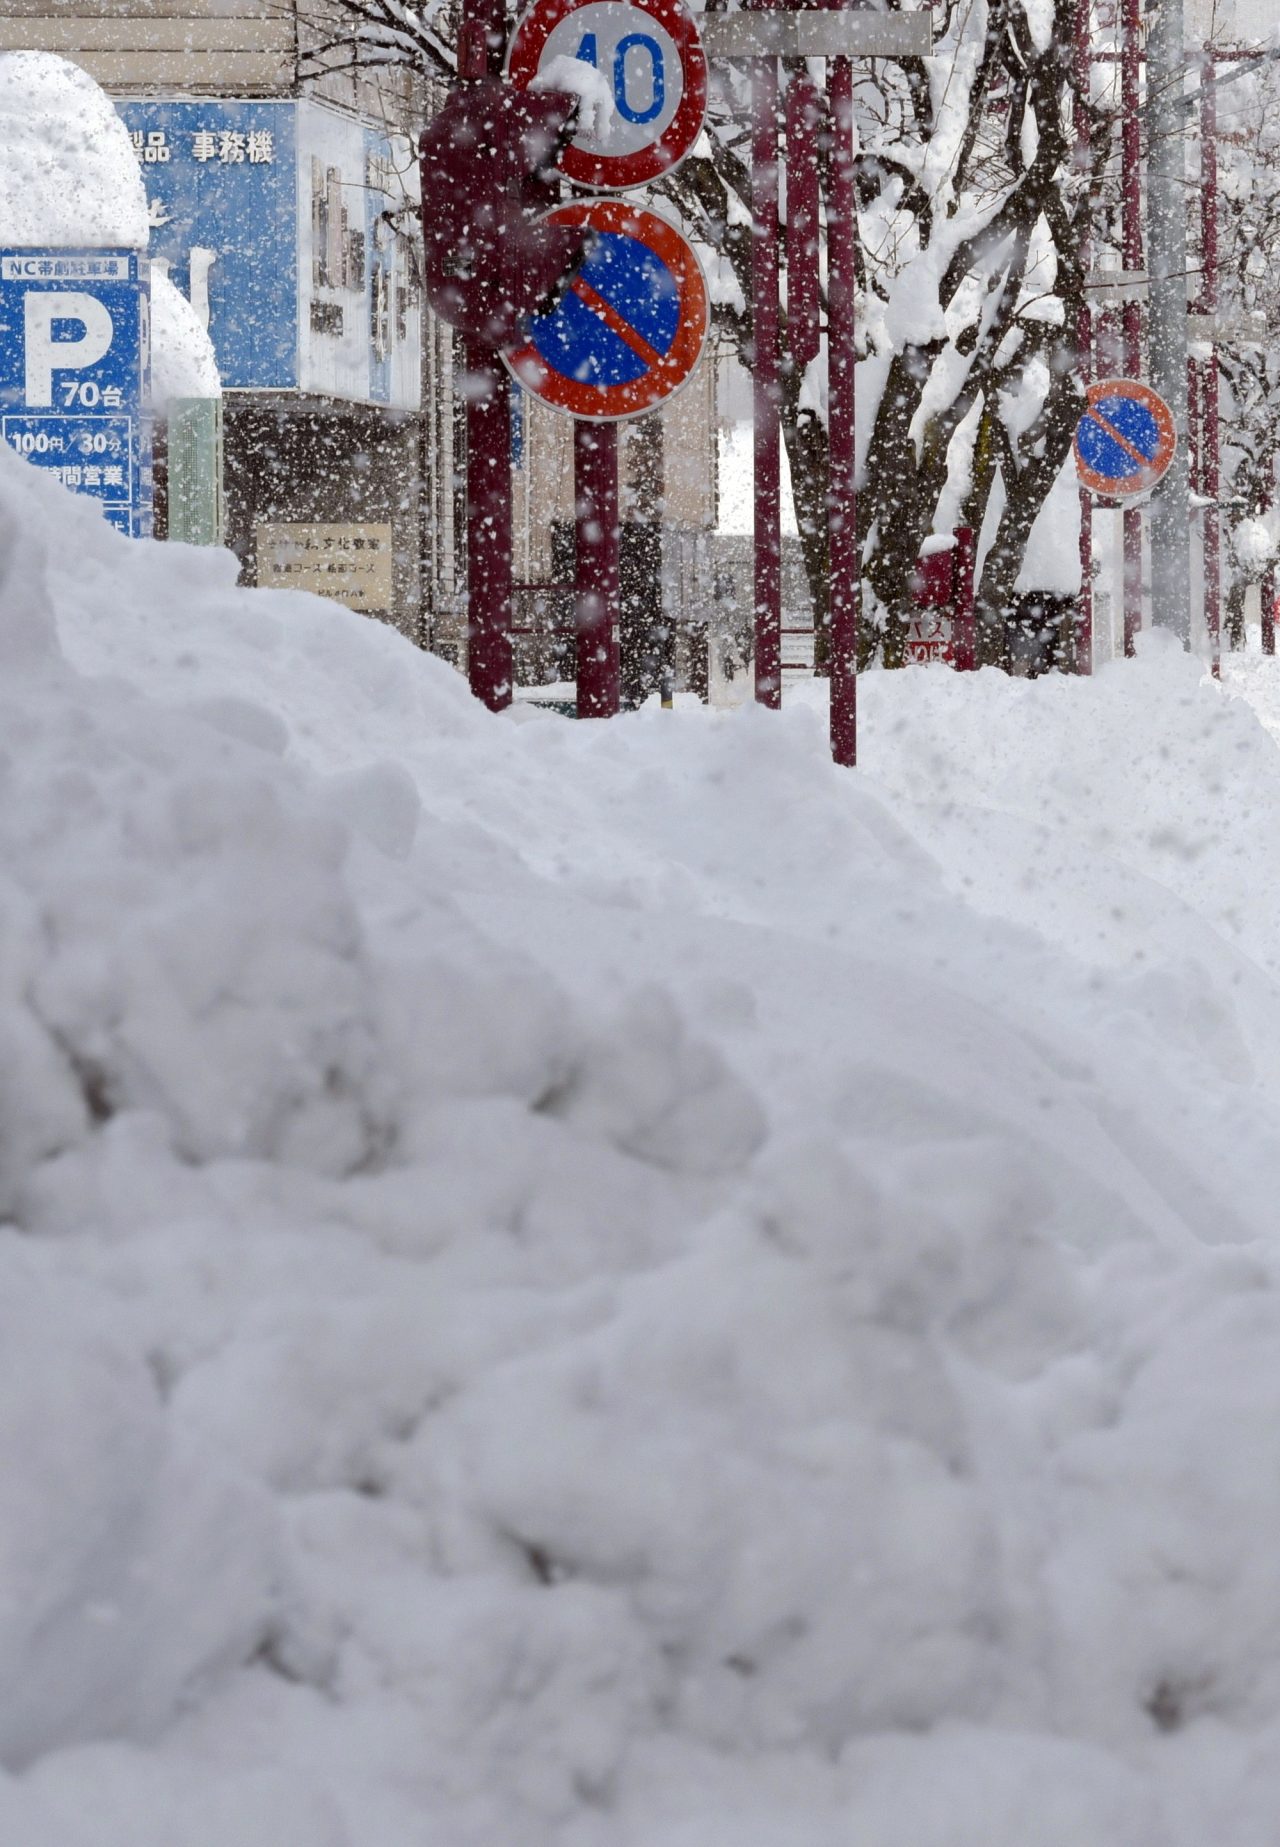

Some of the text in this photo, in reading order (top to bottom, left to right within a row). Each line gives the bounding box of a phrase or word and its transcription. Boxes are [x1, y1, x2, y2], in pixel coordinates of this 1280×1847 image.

[192, 130, 273, 163] 事務機
[25, 291, 113, 407] P
[60, 382, 122, 407] 70台
